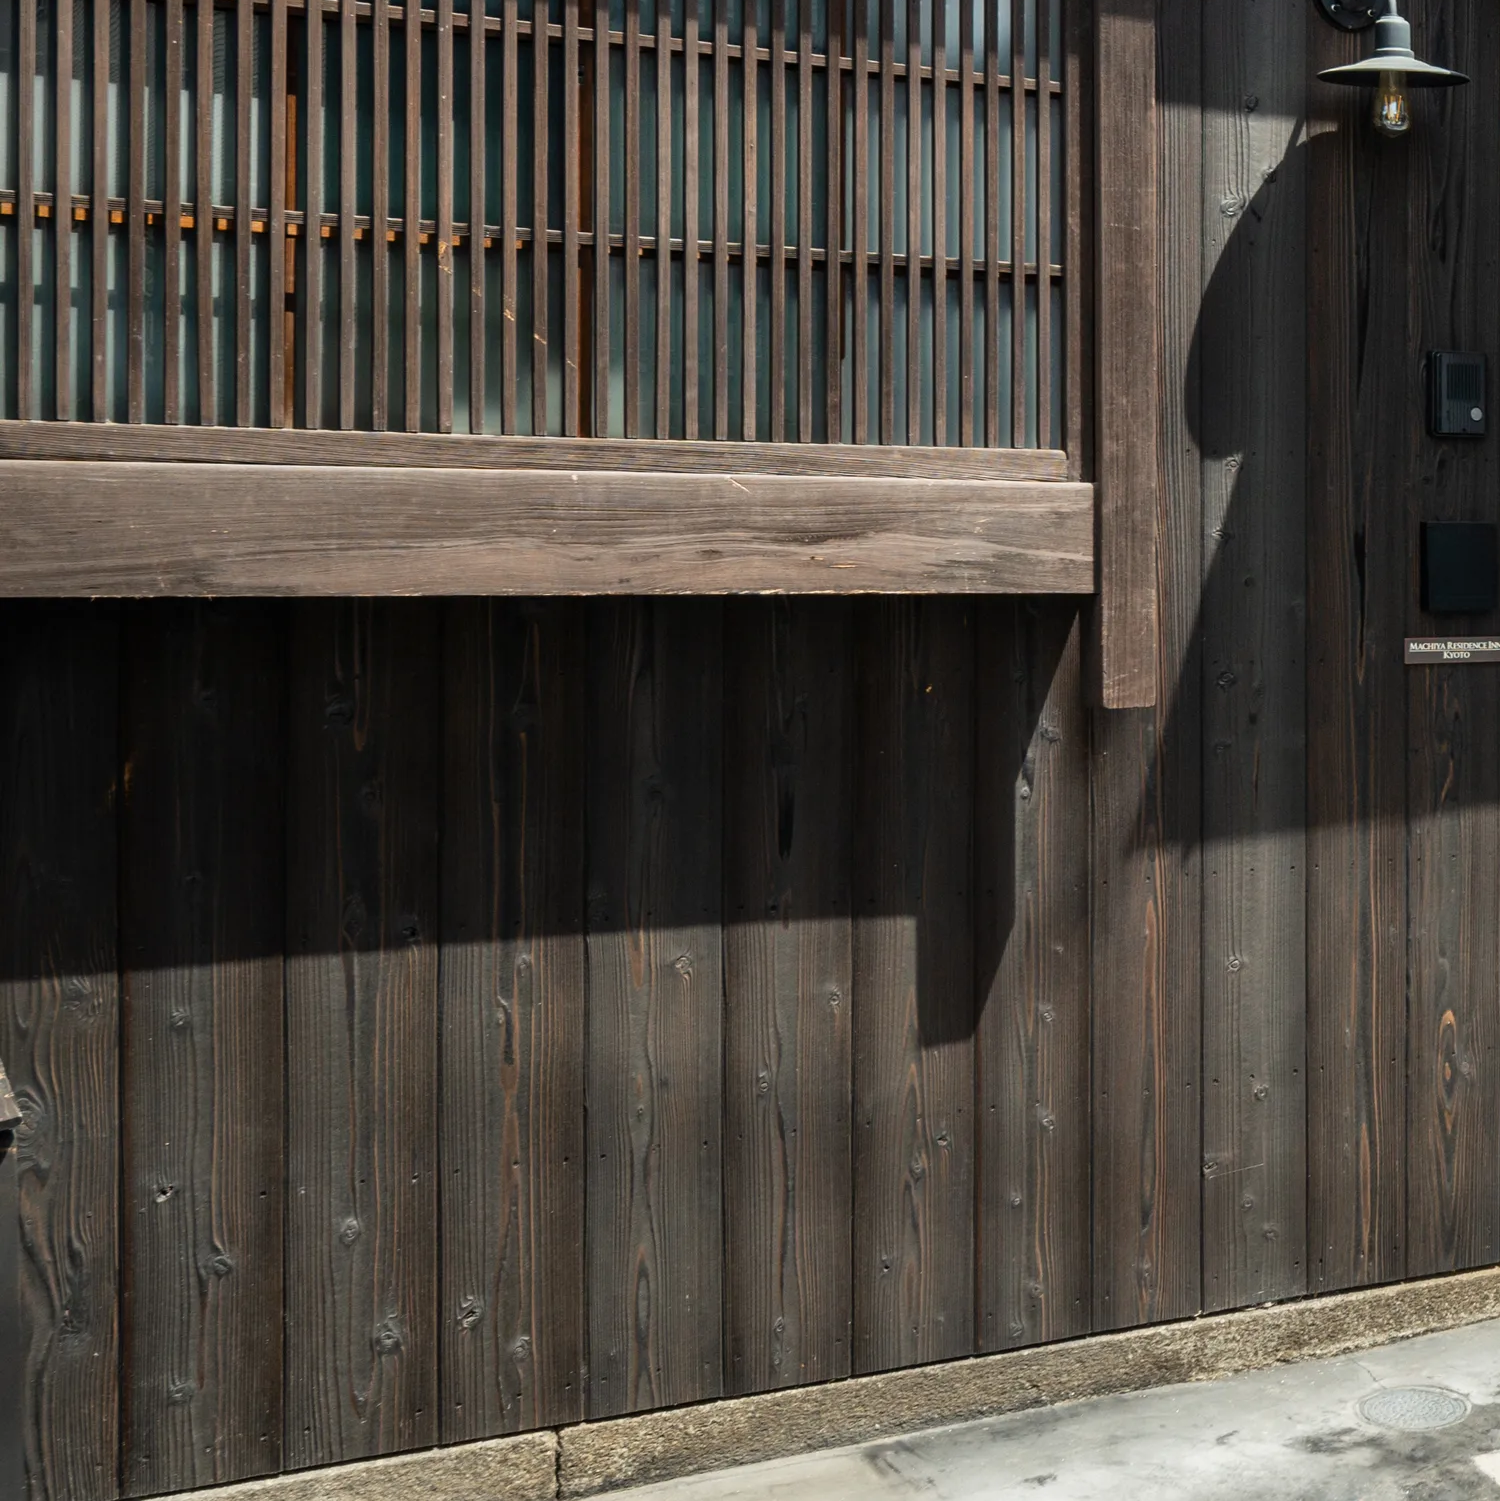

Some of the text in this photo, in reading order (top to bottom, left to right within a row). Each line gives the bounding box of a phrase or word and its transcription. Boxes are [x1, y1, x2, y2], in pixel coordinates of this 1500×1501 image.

[1409, 642, 1446, 650] MACHIYA
[1447, 641, 1488, 650] RESIDENCE
[1443, 651, 1471, 659] KYOTO
